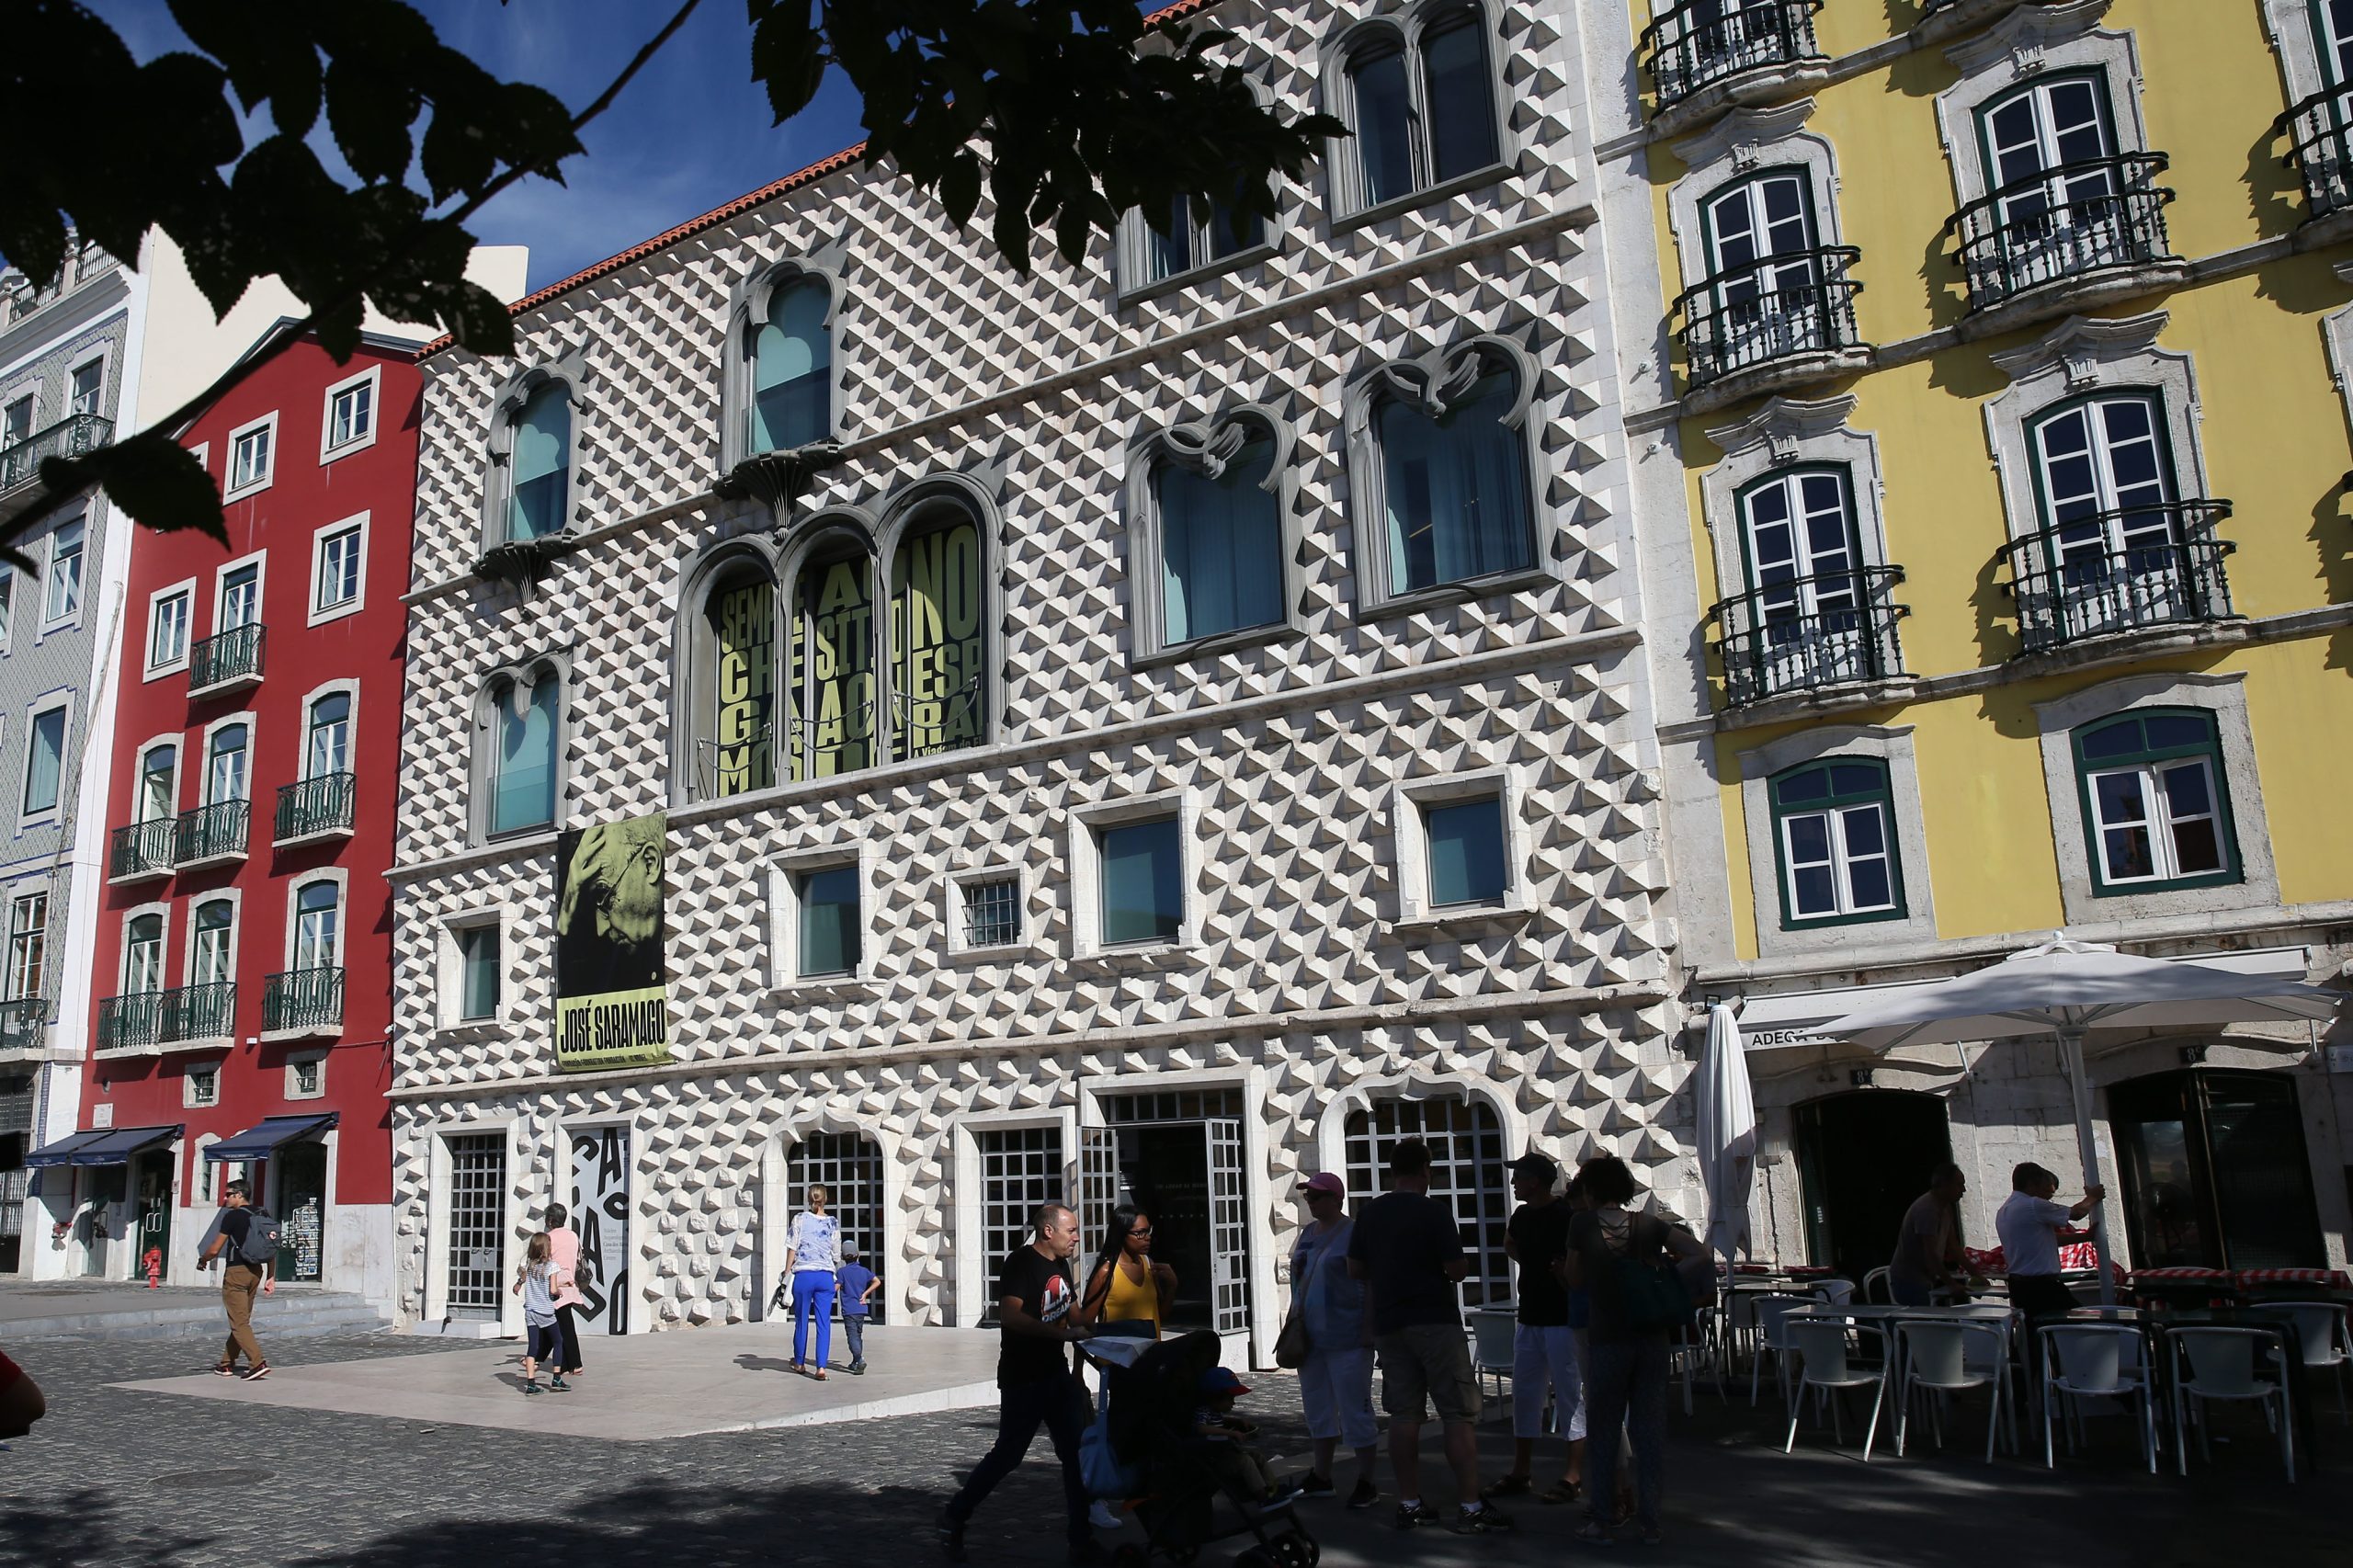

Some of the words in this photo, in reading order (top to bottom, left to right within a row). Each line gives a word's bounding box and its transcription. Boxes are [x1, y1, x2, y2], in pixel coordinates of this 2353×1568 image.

[721, 574, 805, 654] SEMPE
[560, 999, 592, 1053] JOSÉ
[595, 997, 665, 1051] SARAMAGO
